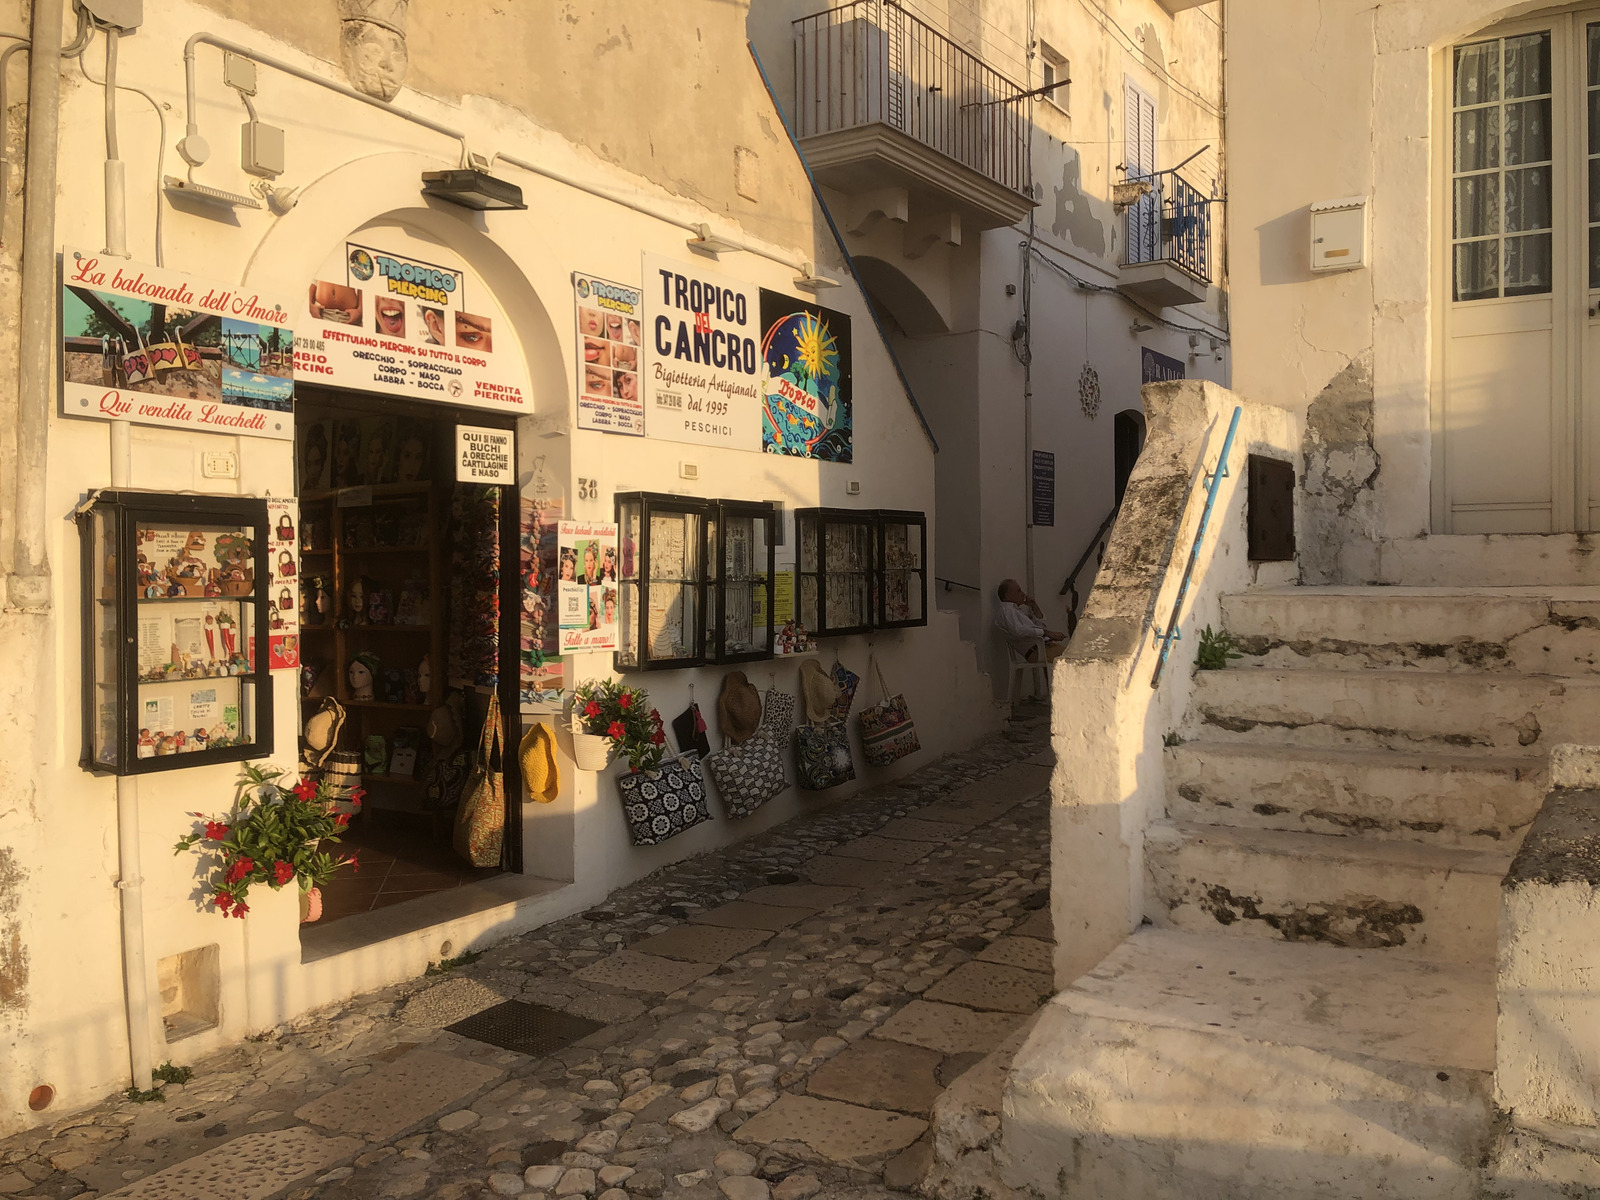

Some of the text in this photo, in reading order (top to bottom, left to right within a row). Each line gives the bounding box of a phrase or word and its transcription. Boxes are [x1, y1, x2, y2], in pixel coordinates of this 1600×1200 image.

[376, 255, 456, 293] TROPICO
[71, 257, 288, 324] La balconata dell'Amore
[388, 278, 448, 306] PIERCING
[591, 280, 639, 306] TROPICO
[658, 268, 747, 326] TROPICO
[597, 296, 634, 315] PIERCING
[694, 312, 713, 334] DEL
[322, 329, 487, 368] EFFETTUIAMO PIERCING SU TUTTO IL CORPO
[655, 314, 756, 375] CANCRO
[352, 350, 396, 364] ORECCHIO
[407, 359, 463, 376] SOPRACCIGLIO
[378, 364, 407, 376] CORPO
[419, 371, 441, 381] NASO
[652, 361, 758, 399] Bigiotteria Artigianale
[373, 373, 406, 386] LABBRA
[417, 380, 445, 391] BOCCA
[475, 380, 521, 396] VENDITA
[474, 389, 524, 404] PIERCING
[99, 390, 267, 430] Qui vendita Lucchetti
[579, 401, 605, 411] ORECCHIO
[595, 410, 612, 419] CORPO
[705, 400, 728, 416] 1995
[592, 417, 611, 426] LABBRA
[618, 420, 633, 428] BOCCA
[684, 420, 732, 436] PESCHICI
[462, 432, 508, 445] QUI SI FANNO
[470, 442, 501, 453] BUCHI
[462, 451, 509, 462] A ORECCHIE
[462, 459, 508, 470] CARTILAGINE
[479, 469, 499, 478] NASO
[577, 477, 598, 500] 38
[584, 637, 589, 645] a
